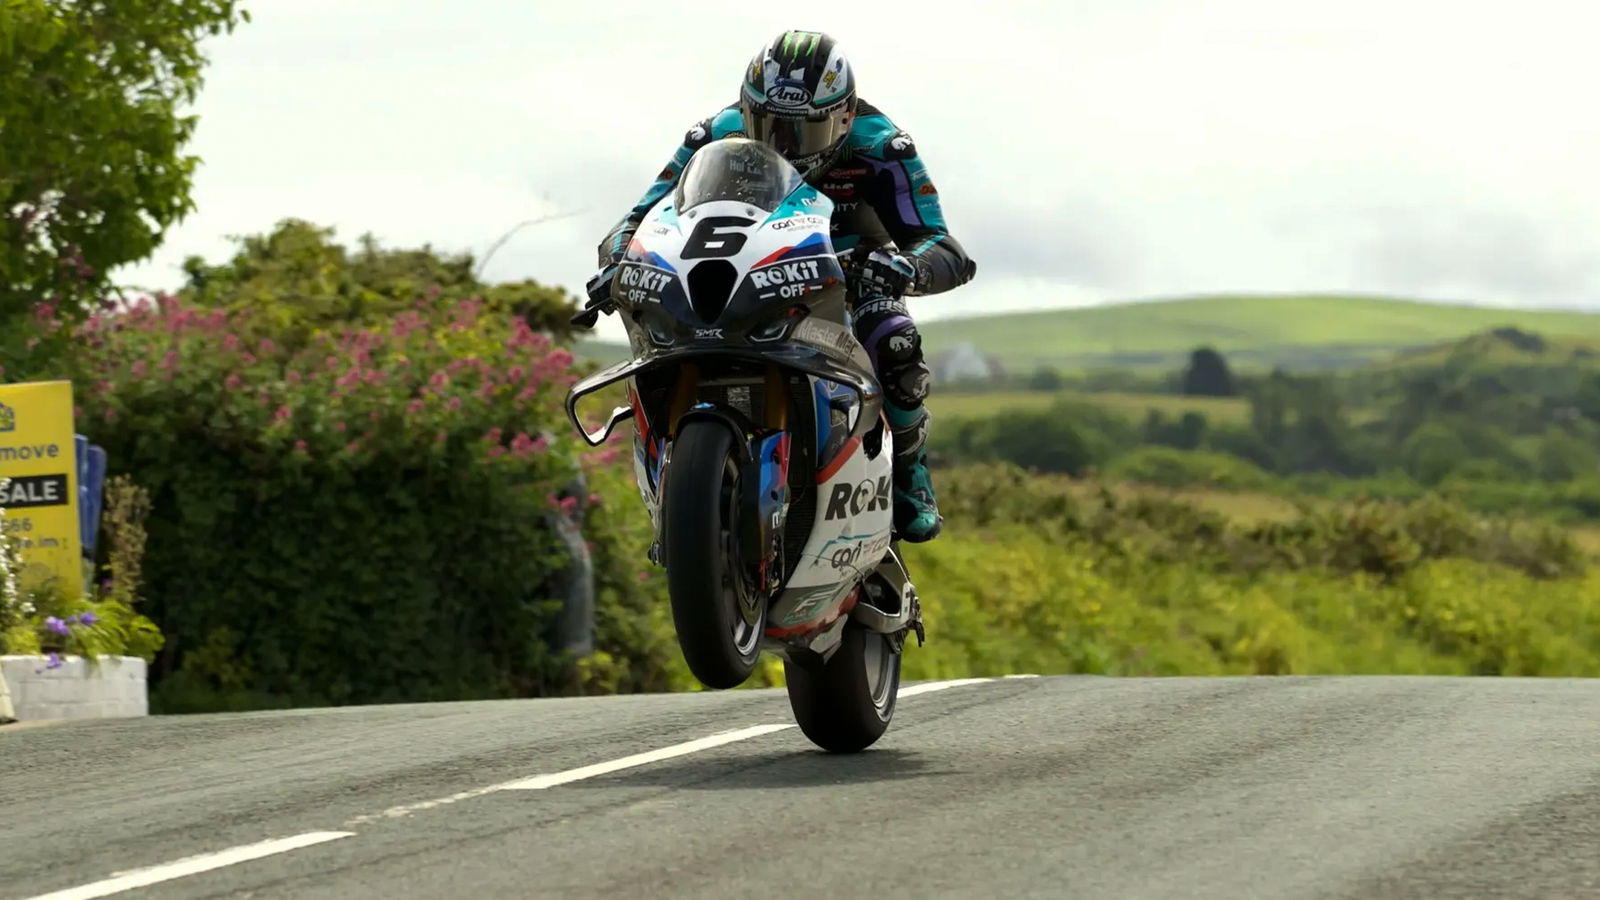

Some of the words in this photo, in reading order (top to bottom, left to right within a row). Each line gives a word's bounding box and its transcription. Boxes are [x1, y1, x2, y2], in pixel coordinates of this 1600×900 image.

[769, 86, 806, 101] Arai
[680, 216, 757, 260] 6
[628, 289, 647, 303] OFF
[780, 283, 806, 298] OFF
[0, 480, 59, 503] SALE
